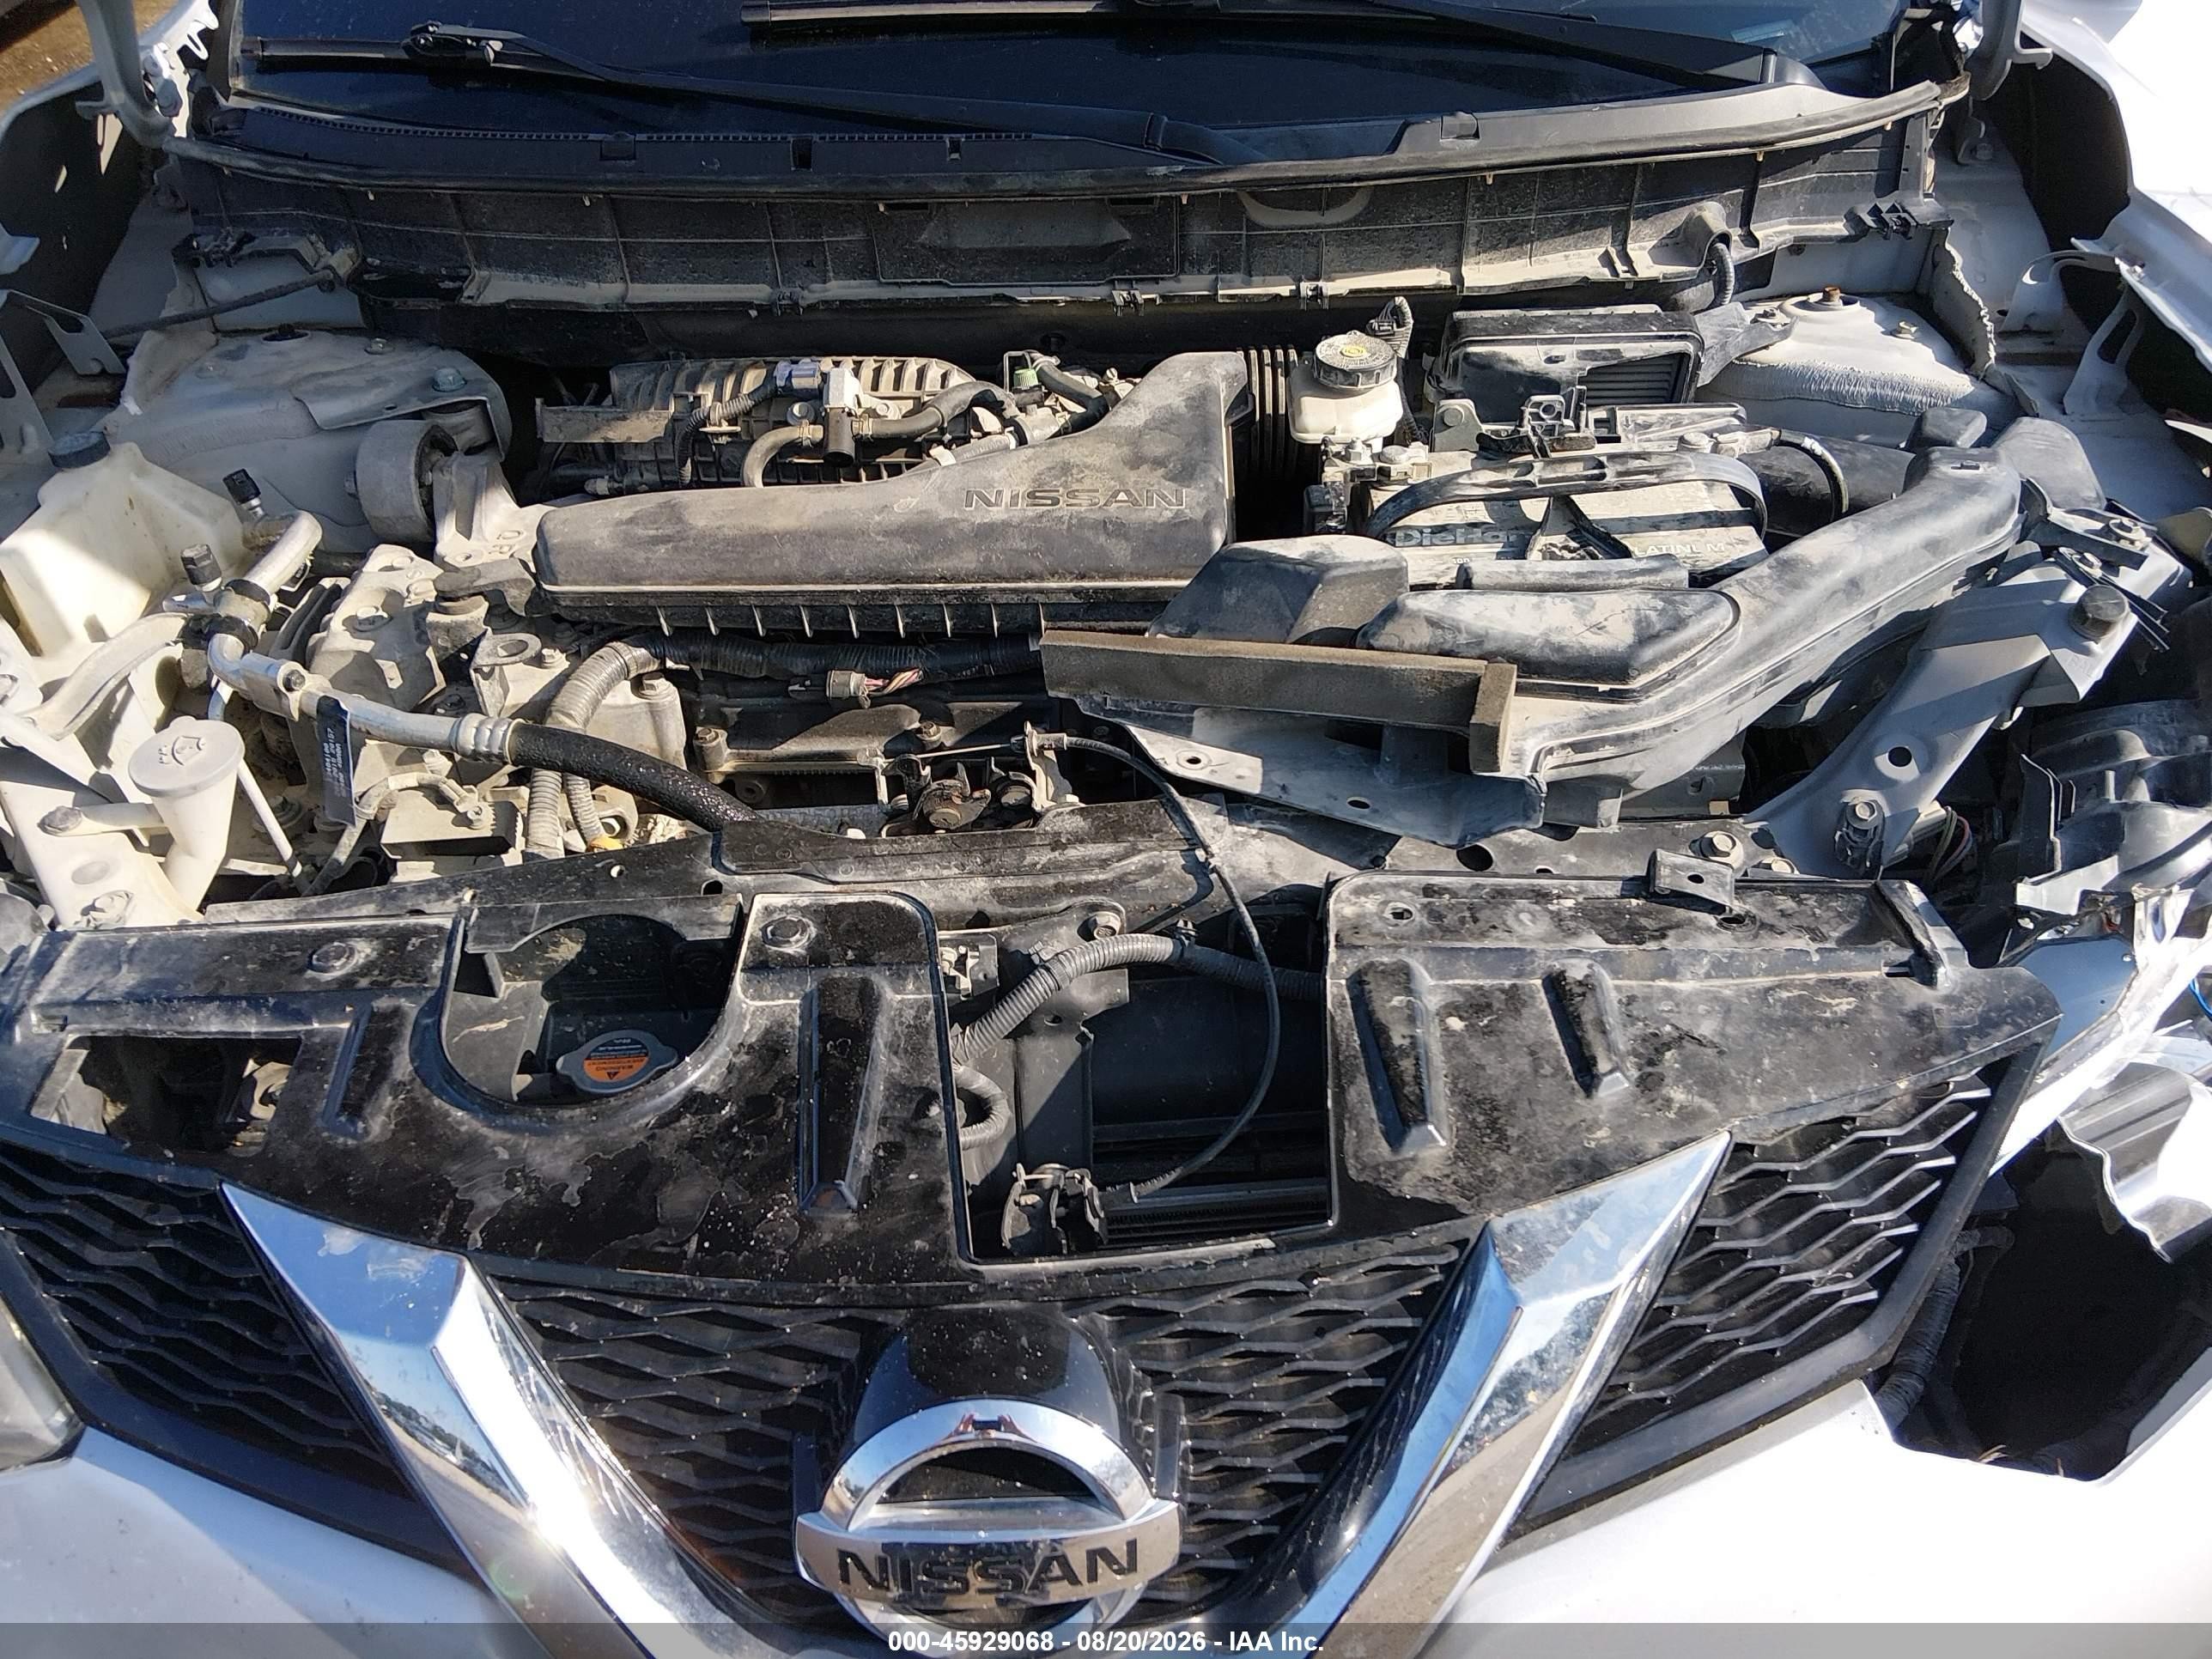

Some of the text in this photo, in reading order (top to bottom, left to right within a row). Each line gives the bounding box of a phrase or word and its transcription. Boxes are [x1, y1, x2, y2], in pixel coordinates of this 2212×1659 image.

[964, 489, 1186, 509] NISSAN
[1395, 527, 1522, 547] DieHar
[838, 1538, 1138, 1595] NISSAN
